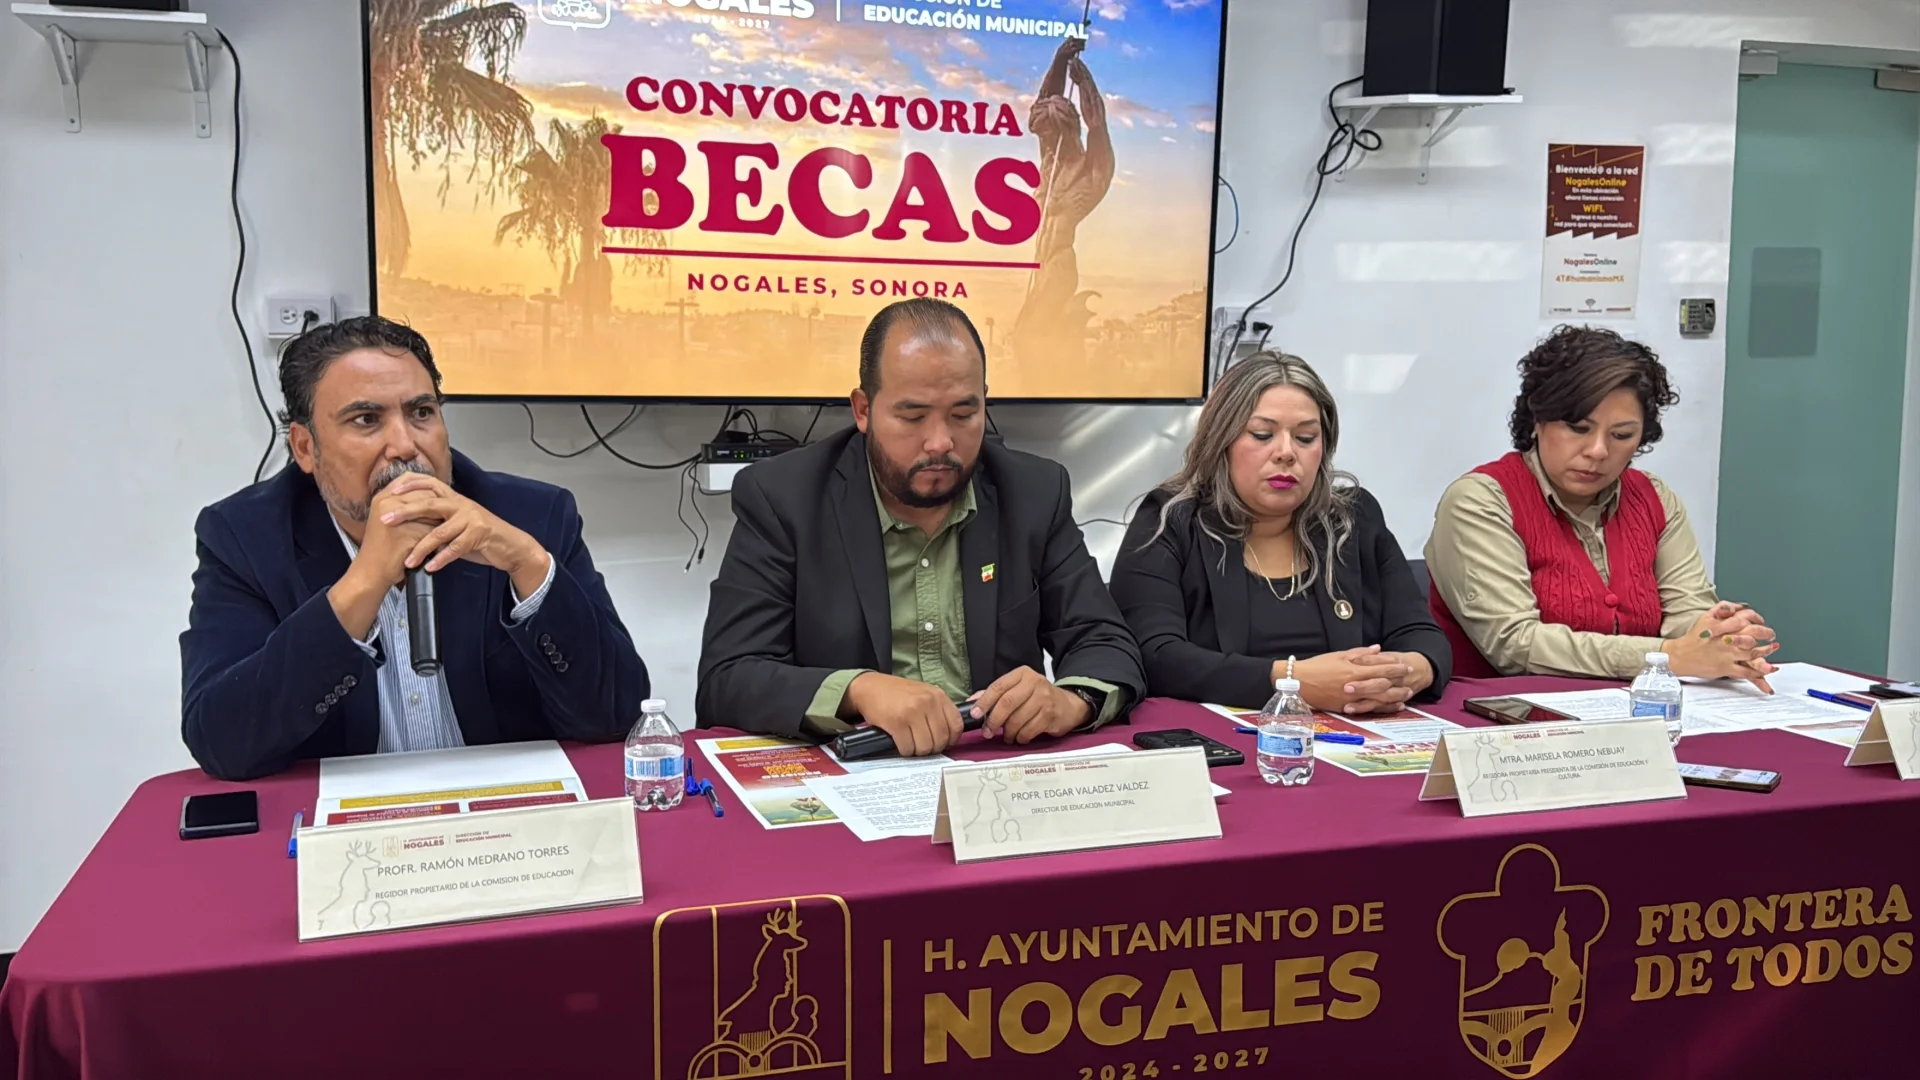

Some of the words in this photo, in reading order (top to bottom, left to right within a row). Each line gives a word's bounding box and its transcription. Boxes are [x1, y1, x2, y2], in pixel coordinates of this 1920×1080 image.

[864, 5, 981, 30] EDUCACIÓN
[985, 16, 1088, 39] MUNICIPAL
[625, 76, 1023, 137] CONVOCATORIA
[1565, 177, 1627, 187] NogalesOnline
[1606, 167, 1612, 175] a
[1613, 166, 1622, 175] la
[1623, 166, 1639, 175] red
[601, 133, 1041, 245] BECAS
[687, 273, 838, 298] NOGALES,
[851, 278, 968, 299] SONORA
[1525, 752, 1561, 763] MARISELA
[1562, 748, 1595, 759] ROMERO
[1596, 746, 1625, 757] NEBUAY
[1044, 788, 1074, 799] EDGAR
[1075, 784, 1115, 796] VALADEZ
[1116, 781, 1149, 792] VALDEZ
[1031, 805, 1060, 814] DIRECTOR
[1069, 801, 1103, 810] EDUCACIÓN
[1104, 799, 1135, 807] MUNICIPAL
[403, 839, 444, 849] NOGALES
[377, 864, 417, 877] PROFR.
[420, 857, 464, 873] RAMÓN
[467, 850, 525, 866] MEDRANO
[528, 845, 570, 859] TORRES
[375, 889, 408, 899] REGIDOR
[410, 883, 458, 897] PROPIETARIO
[460, 880, 469, 889] DE
[471, 880, 480, 888] LA
[521, 874, 530, 882] DE
[532, 869, 574, 880] EDUCACION
[1635, 883, 1912, 946] FRONTERA
[924, 938, 967, 973] H.
[979, 907, 1319, 968] AYUNTAMIENTO
[1332, 901, 1385, 936] DE
[1631, 950, 1713, 1002] DE
[1727, 933, 1913, 991] TODOS
[923, 950, 1381, 1065] NOGALES
[1079, 1060, 1160, 1080] 2024
[1193, 1047, 1269, 1073] 2027
